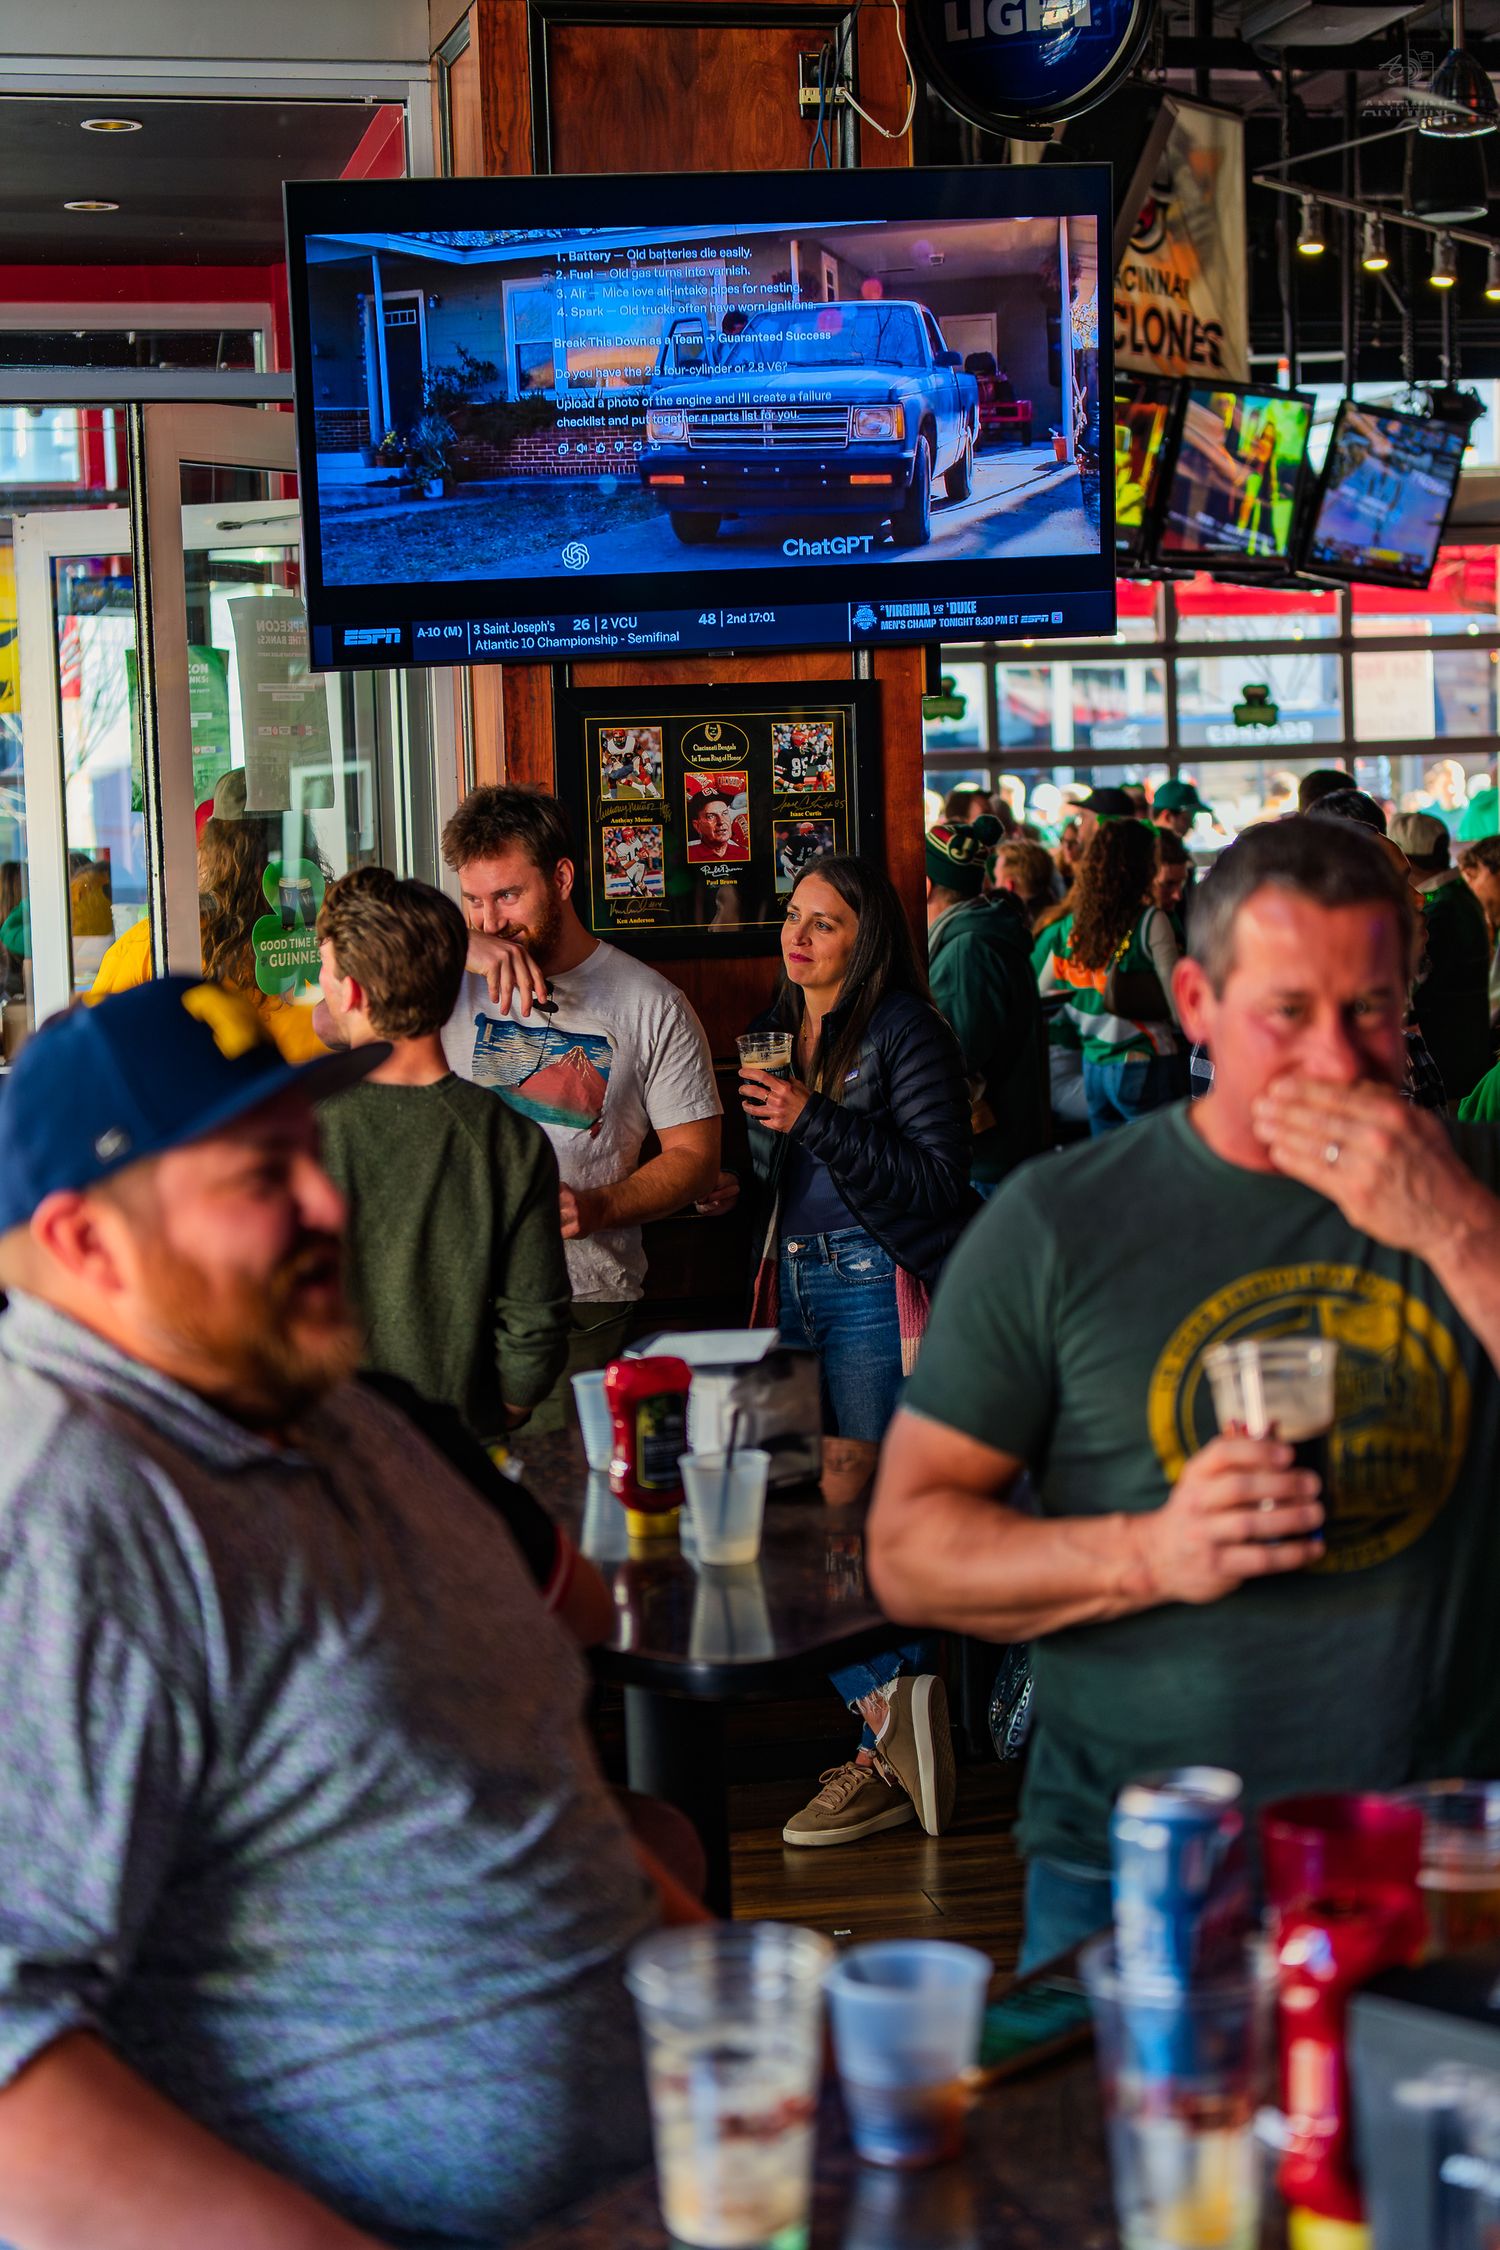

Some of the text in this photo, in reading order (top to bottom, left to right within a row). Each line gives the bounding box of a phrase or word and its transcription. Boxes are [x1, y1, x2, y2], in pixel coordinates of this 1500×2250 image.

[556, 251, 566, 262] 1.
[569, 250, 611, 263] Battery
[627, 248, 646, 260] Old
[649, 247, 697, 260] batteries
[700, 247, 717, 258] die
[720, 246, 752, 260] easily.
[556, 270, 567, 280] 2.
[570, 269, 594, 280] Fuel
[609, 268, 629, 279] Old
[632, 269, 651, 281] gas
[655, 267, 682, 278] turns
[685, 266, 706, 277] into
[708, 264, 751, 276] varnish.
[556, 288, 567, 299] 3.
[570, 287, 586, 299] Air
[602, 287, 629, 298] Mice
[632, 286, 654, 297] love
[656, 284, 708, 297] air-intake
[710, 284, 740, 296] pipes
[743, 283, 758, 294] for
[760, 281, 803, 294] nesting.
[556, 306, 568, 317] 4.
[570, 306, 604, 319] Spark
[620, 304, 638, 316] Old
[641, 302, 675, 314] trucks
[678, 301, 707, 313] often
[710, 300, 735, 313] have
[738, 301, 765, 312] worn
[767, 299, 816, 314] ignitions.
[554, 330, 832, 349] Break This Down as a Team Guaranteed Success
[555, 360, 788, 381] Do you have the 2.5 four-cylinder or 2.8 V6?
[556, 390, 832, 412] Upload a photo of the engine and I'll create a failure
[556, 409, 800, 428] checklist and put together a parts list for you.
[782, 535, 873, 556] ChatGPT
[573, 618, 590, 631] 26
[601, 617, 638, 630] 2 VCU
[698, 613, 716, 625] 48
[726, 612, 776, 624] 2nd 17:01
[880, 614, 1049, 631] MEN'S CHAMP TONIGHT 8:30 PM ET ESPN
[343, 628, 400, 646] ESPN
[417, 625, 463, 638] A-10 (M)
[473, 620, 555, 637] 3 Saint Joseph's
[475, 638, 519, 651] Atlantic
[521, 637, 534, 649] 10
[537, 632, 618, 648] Championship
[627, 631, 680, 644] Semifinal
[610, 817, 633, 825] Anthony
[260, 939, 287, 951] GOOD
[289, 936, 311, 949] TIME
[270, 950, 322, 967] GUINNES
